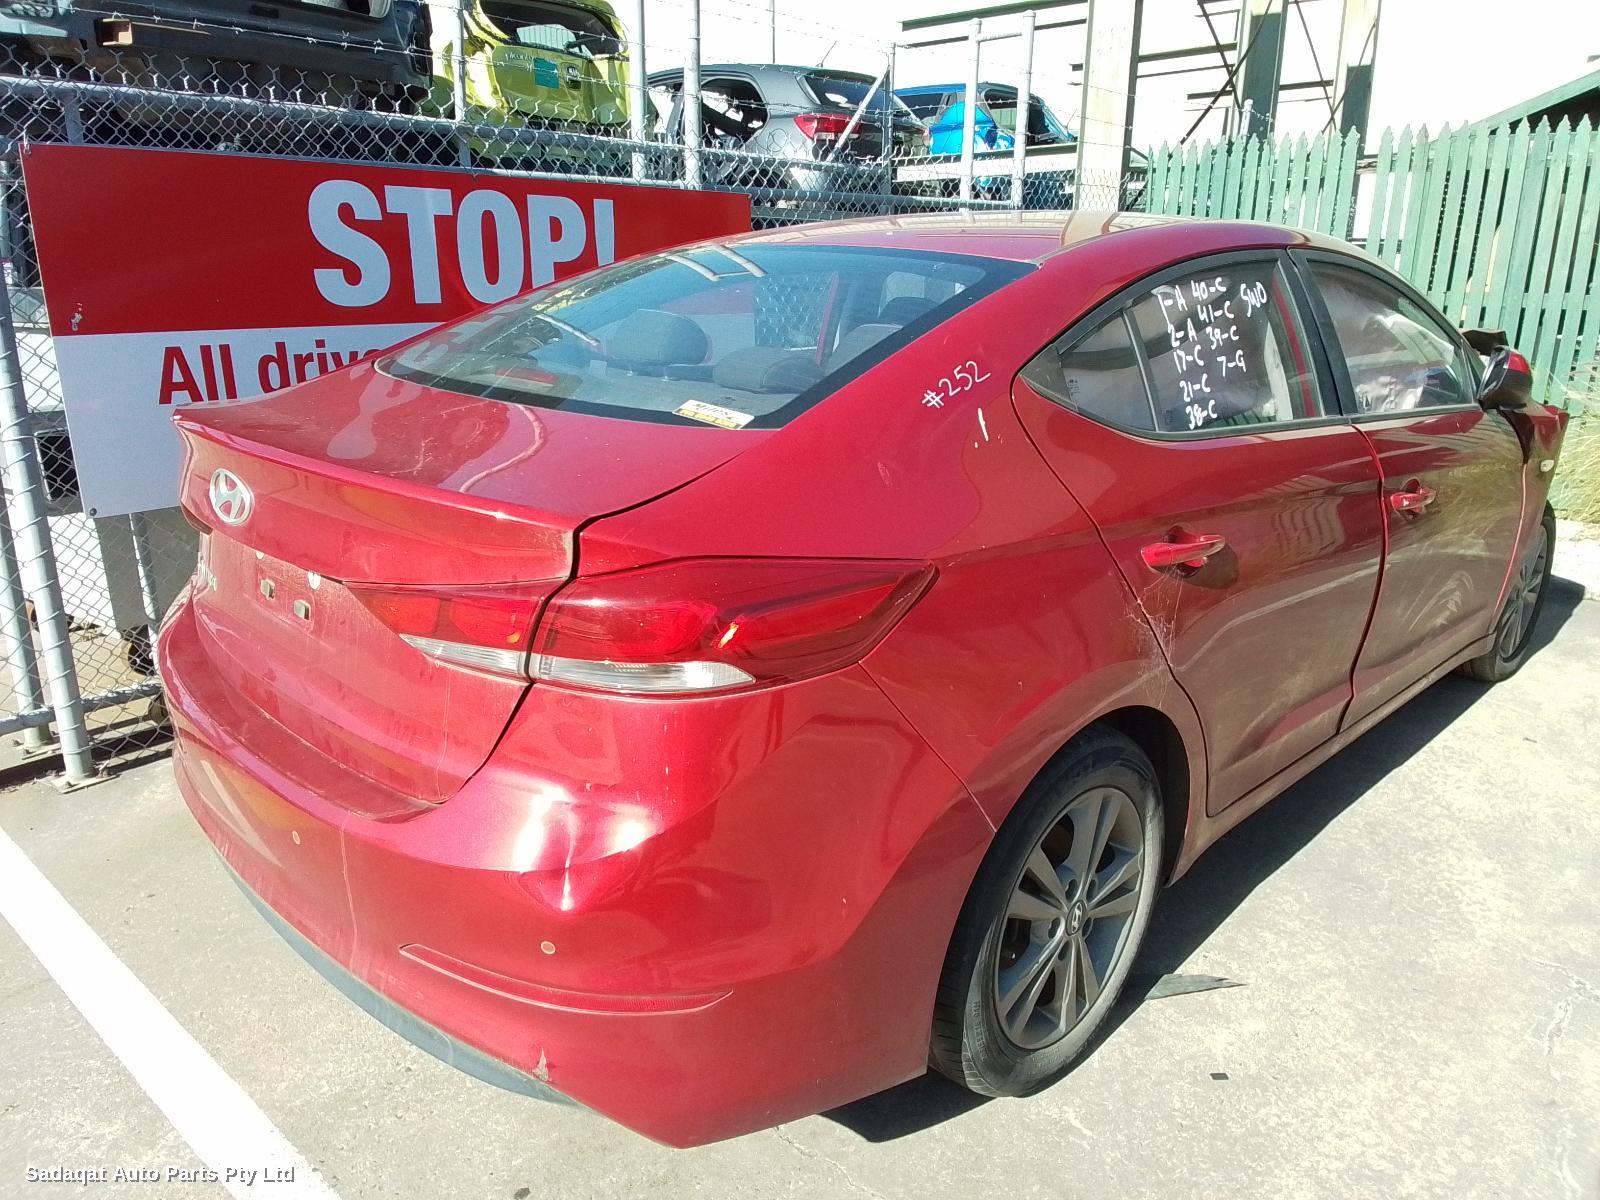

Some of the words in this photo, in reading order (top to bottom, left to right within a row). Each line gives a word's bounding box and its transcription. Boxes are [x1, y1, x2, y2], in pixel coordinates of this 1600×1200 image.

[308, 180, 615, 307] STOP!
[159, 344, 238, 405] All
[258, 339, 384, 394] dri
[921, 360, 992, 408] #252
